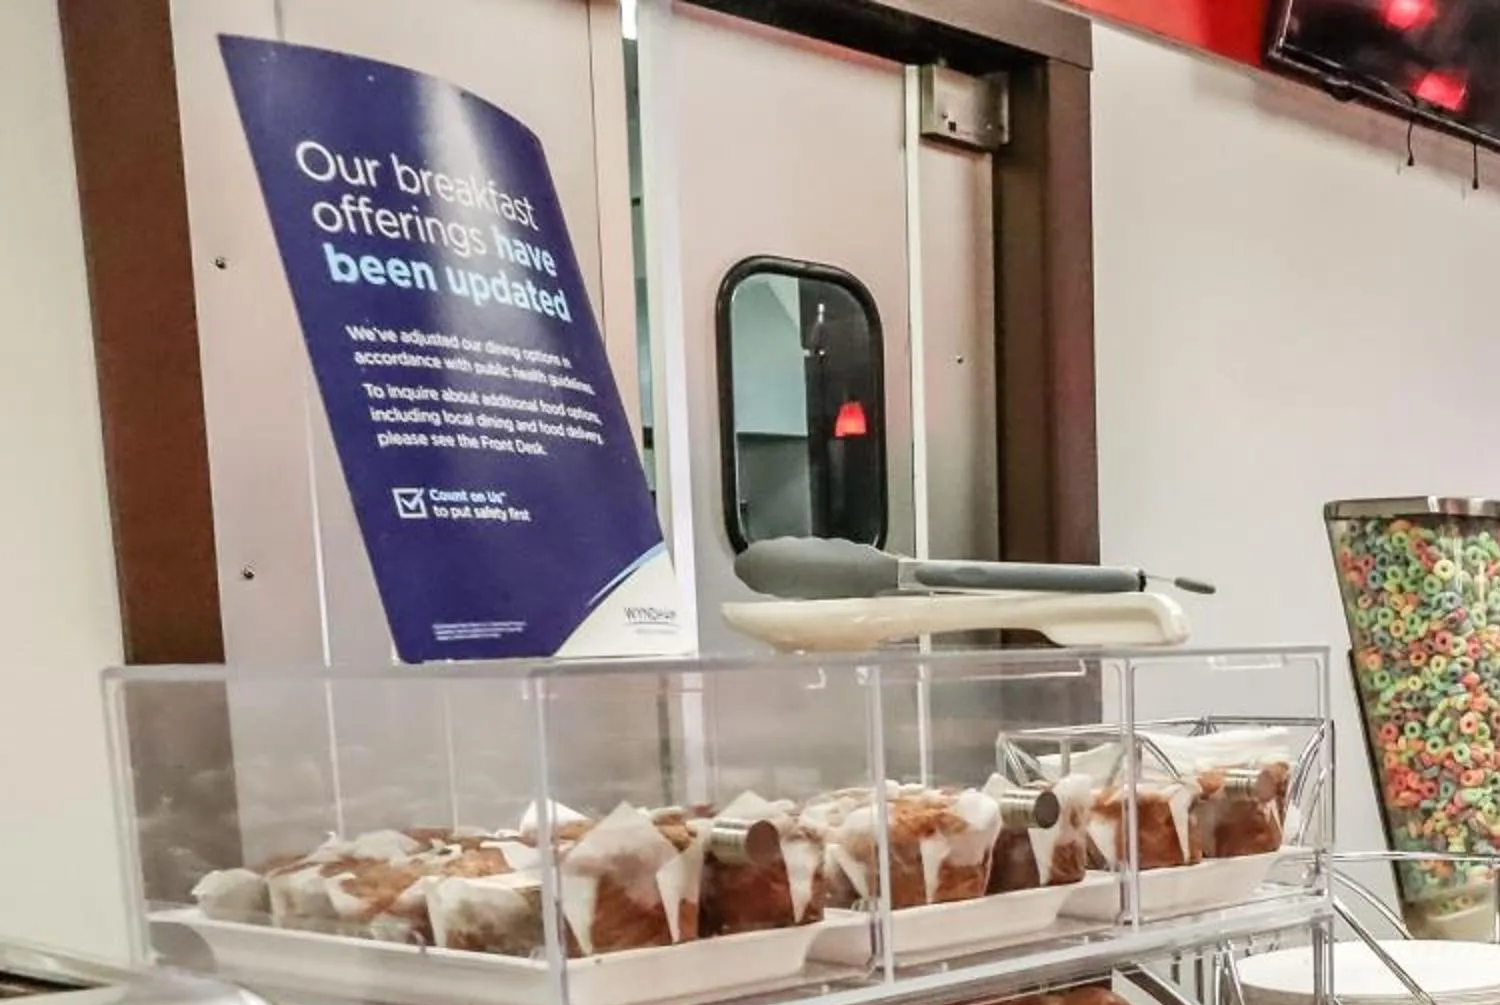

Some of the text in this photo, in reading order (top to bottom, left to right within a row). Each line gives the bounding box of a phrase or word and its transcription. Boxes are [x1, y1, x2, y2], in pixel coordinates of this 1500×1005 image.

[296, 140, 540, 232] Our breakfast
[312, 195, 557, 278] offerings have
[322, 241, 572, 324] been updated
[345, 325, 398, 343] We've
[400, 329, 459, 350] adjusted
[461, 338, 481, 352] our
[522, 349, 562, 367] options
[354, 352, 442, 369] accordance
[443, 357, 473, 372] with
[473, 361, 512, 379] public
[511, 365, 548, 383] health
[362, 383, 386, 399] To
[386, 383, 439, 402] inquire
[441, 386, 480, 405] about
[481, 393, 539, 412] additional
[539, 399, 567, 417] food
[368, 404, 442, 426] including
[441, 408, 474, 426] local
[475, 413, 515, 433] dining
[515, 419, 538, 433] and
[537, 419, 565, 437] food
[377, 429, 429, 448] please
[429, 433, 456, 447] see
[456, 432, 480, 449] the
[480, 435, 517, 453] Front
[429, 488, 469, 502] Count
[469, 490, 487, 502] on
[433, 504, 449, 518] to
[449, 506, 473, 519] put
[473, 505, 508, 523] safety
